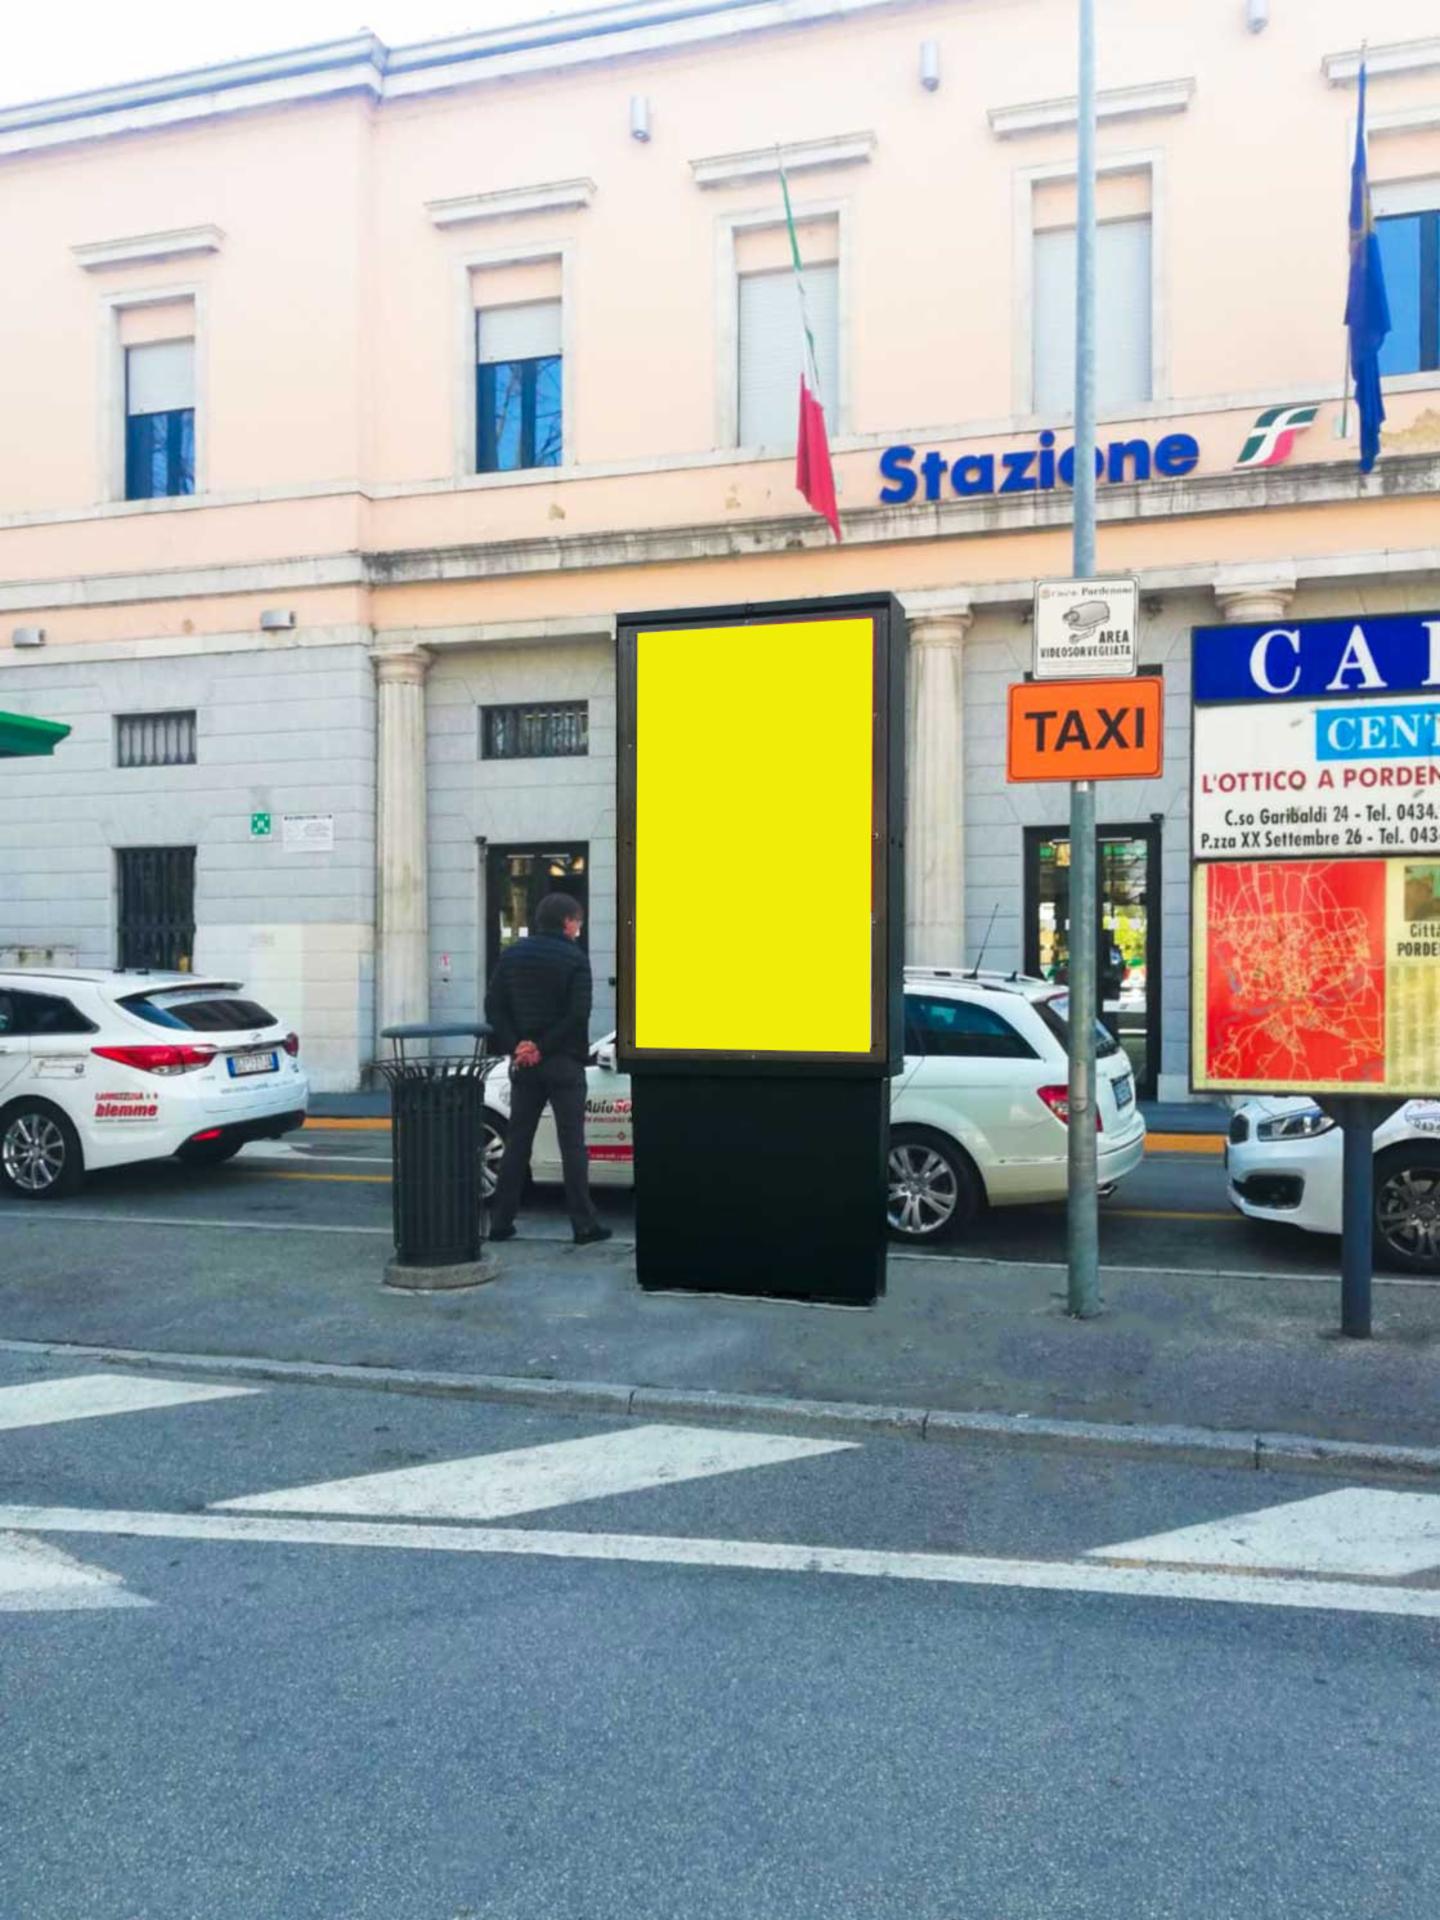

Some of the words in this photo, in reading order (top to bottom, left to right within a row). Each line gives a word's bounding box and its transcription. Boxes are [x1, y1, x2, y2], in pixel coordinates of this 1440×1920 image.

[880, 430, 1200, 504] Stazione
[1099, 630, 1130, 644] AREA
[1040, 645, 1131, 658] VIDEOSORVEGLIATA
[1024, 707, 1145, 752] TAXI
[1202, 770, 1306, 793] L'OTTICO
[1318, 769, 1334, 789] A
[1225, 808, 1254, 826] C.so
[1260, 806, 1327, 825] Garibaldi
[1333, 805, 1349, 823] 24
[1366, 803, 1391, 822] Tel.
[1201, 832, 1236, 849] P.zza
[1241, 831, 1261, 848] XX
[1265, 828, 1340, 848] Settembre
[1345, 828, 1362, 845] 26
[1379, 826, 1404, 844] Tel.
[1410, 826, 1440, 844] 043
[1397, 942, 1440, 957] PORDE
